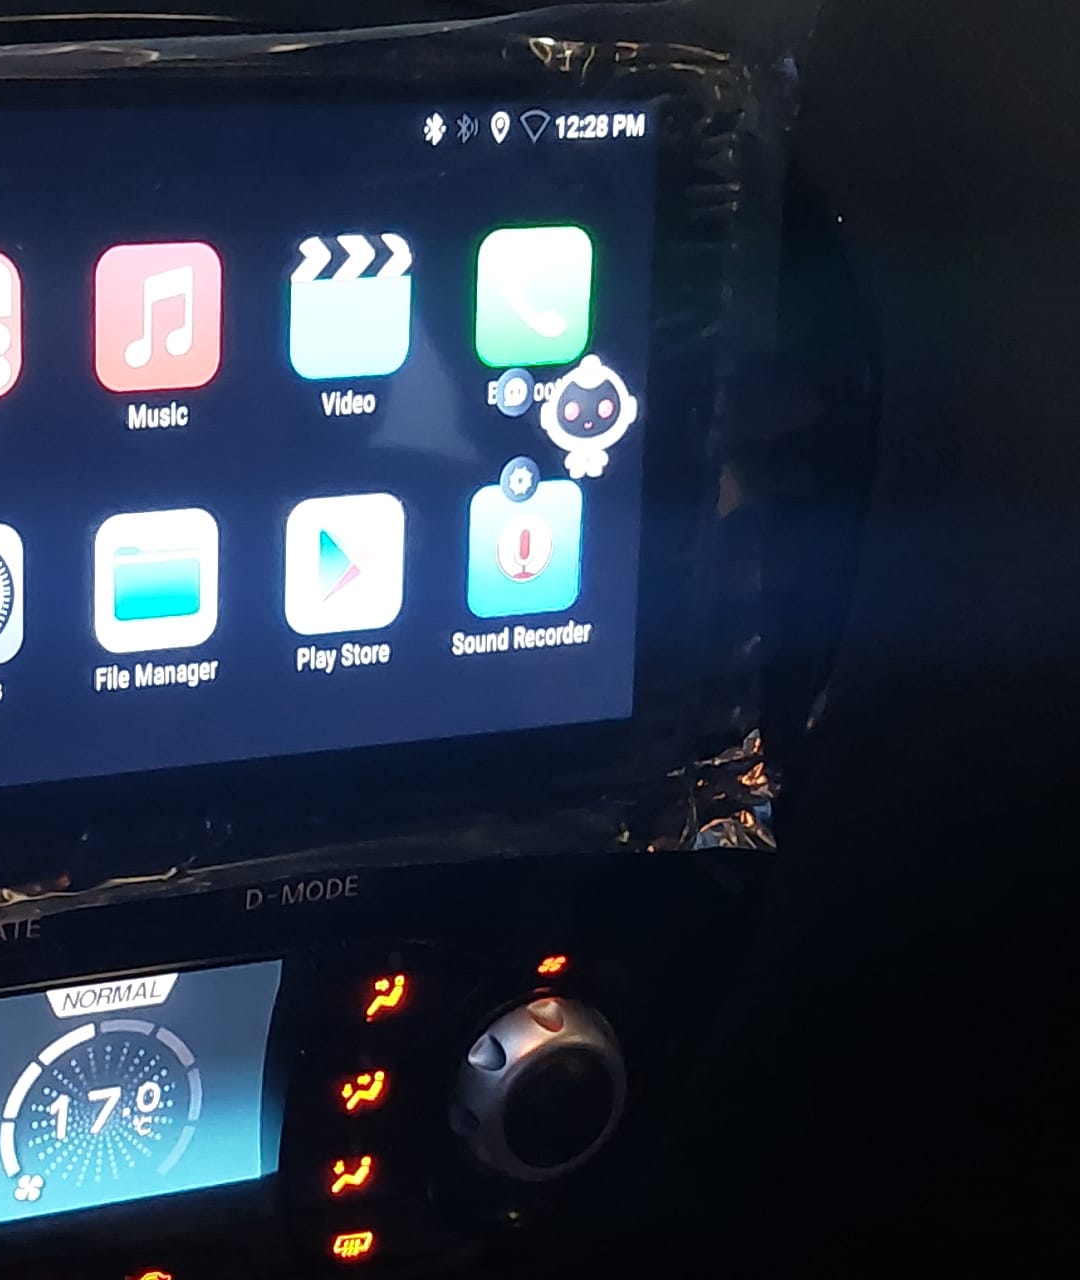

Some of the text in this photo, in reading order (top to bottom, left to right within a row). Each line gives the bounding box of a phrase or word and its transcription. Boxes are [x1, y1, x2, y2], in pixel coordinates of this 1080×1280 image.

[555, 112, 646, 140] 12:28 PM
[127, 401, 190, 430] Music
[320, 389, 377, 417] Video
[451, 620, 593, 656] Sound Recorder
[296, 642, 391, 674] Play Store
[94, 660, 219, 692] File Manager
[245, 875, 360, 910] D-MODE
[61, 980, 162, 1011] NORMAL
